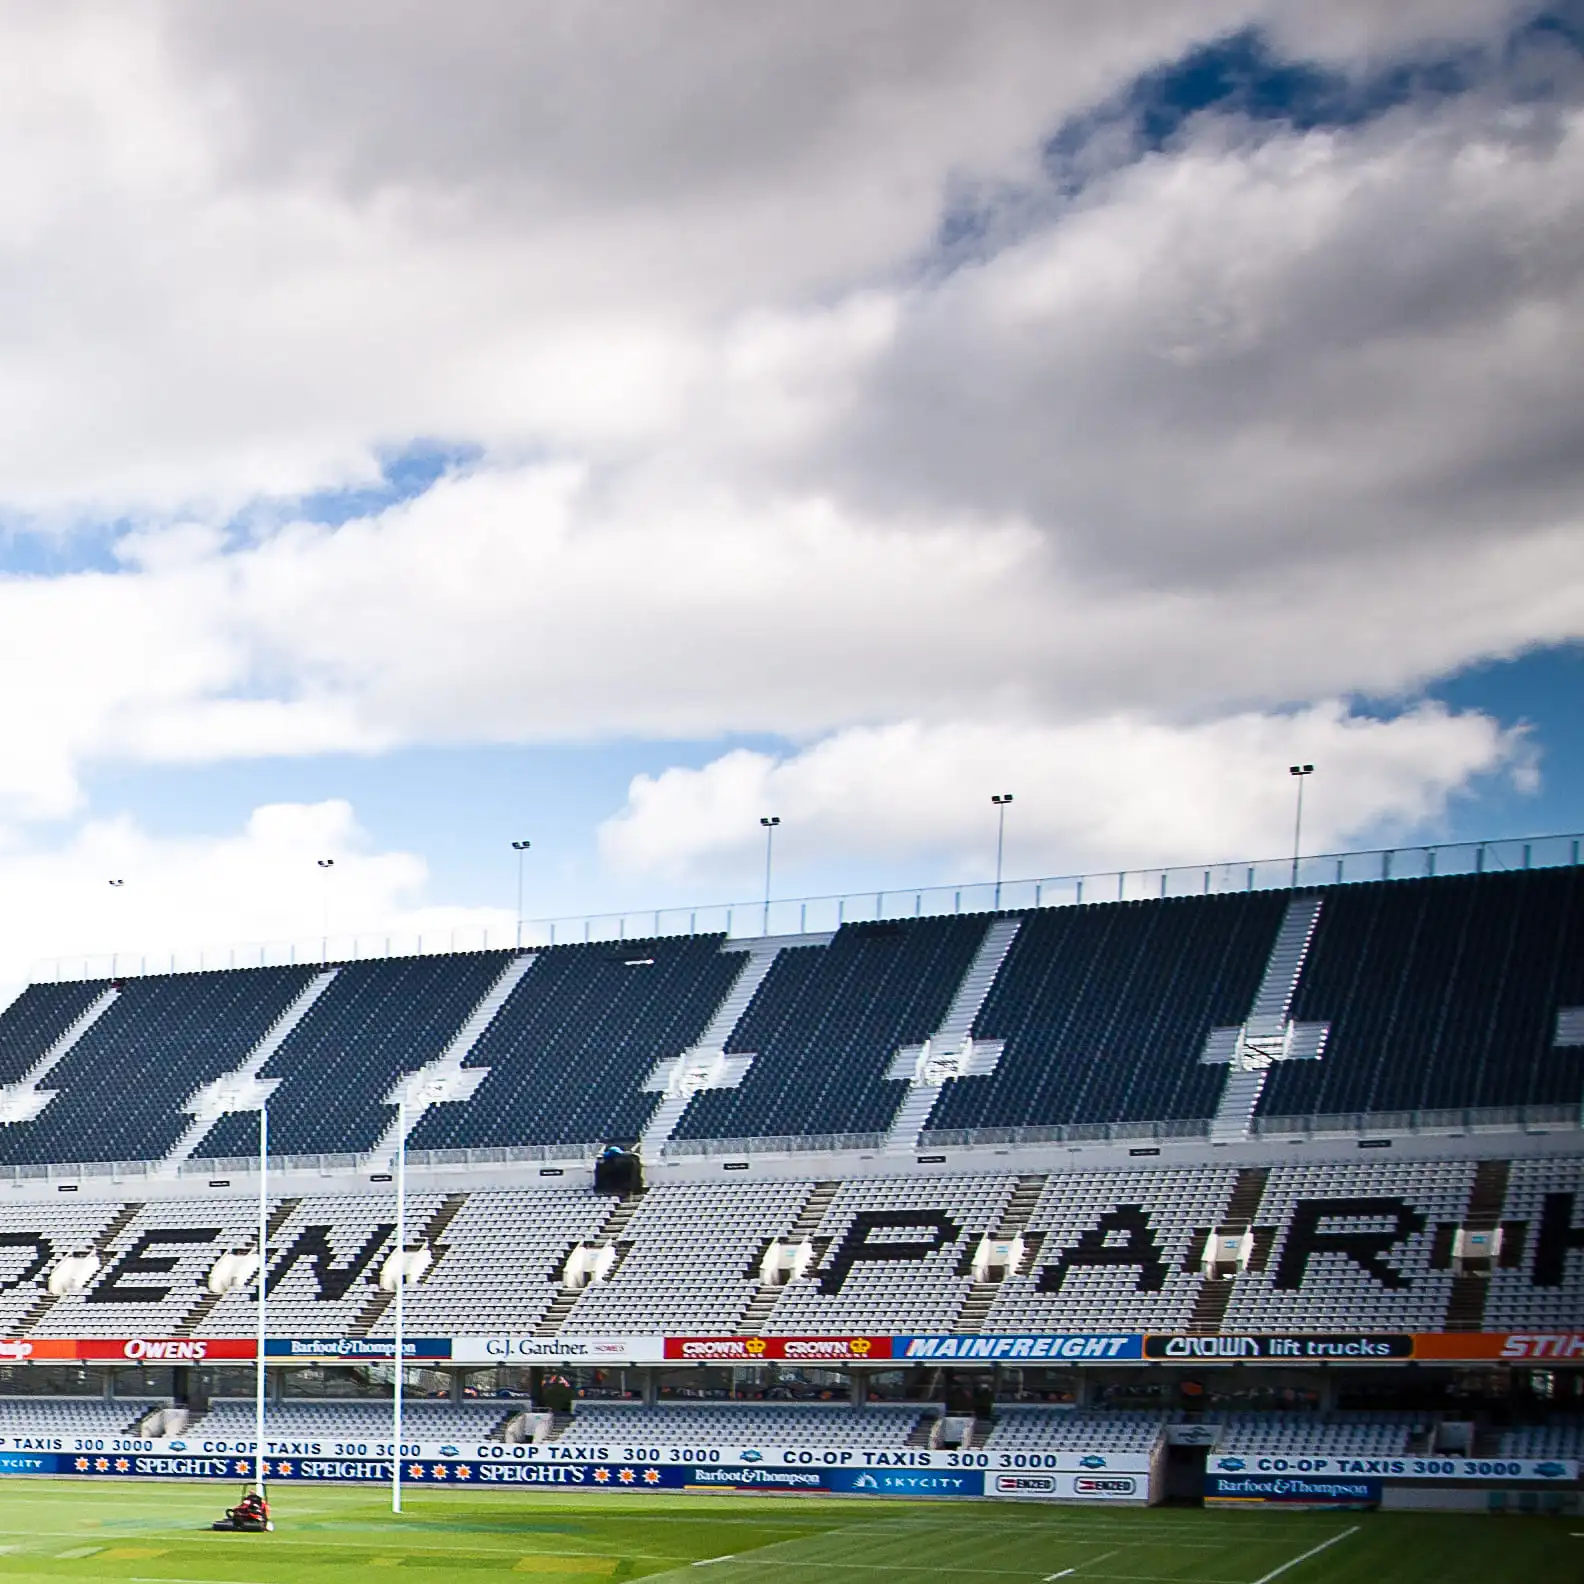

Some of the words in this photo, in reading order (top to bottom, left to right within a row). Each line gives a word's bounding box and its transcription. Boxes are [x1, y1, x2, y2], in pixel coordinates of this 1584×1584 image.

[486, 1340, 514, 1358] G.J.
[682, 1341, 745, 1354] CROWN
[784, 1341, 849, 1354] CROWN
[906, 1338, 1129, 1357] MAINFREIGHT
[1269, 1337, 1304, 1356] lift
[1307, 1339, 1391, 1356] trucks
[14, 1438, 63, 1450] TAXIS
[74, 1439, 105, 1451] 300
[112, 1440, 153, 1452] 3000
[203, 1441, 257, 1453] CO-OP
[269, 1442, 321, 1455] TAXIS
[334, 1443, 368, 1456] 300
[477, 1446, 539, 1459] CO-OP
[550, 1447, 609, 1460] TAXIS
[623, 1448, 660, 1461] 300
[669, 1449, 720, 1462] 3000
[783, 1451, 853, 1464] CO-OP
[864, 1452, 931, 1466] TAXIS
[947, 1453, 989, 1467] 300
[999, 1454, 1057, 1468] 3000
[136, 1458, 228, 1475] SPEIGHT'S
[479, 1464, 585, 1483] SPEIGHT'S
[1258, 1458, 1328, 1472] CO-OP
[1337, 1459, 1405, 1473] TAXIS
[1412, 1460, 1455, 1475] 300
[1463, 1461, 1522, 1476] 3000
[695, 1469, 820, 1485] Barfoot&Thompson
[885, 1477, 964, 1489] SKYCITY
[1217, 1478, 1368, 1497] Barfoot&Thompson
